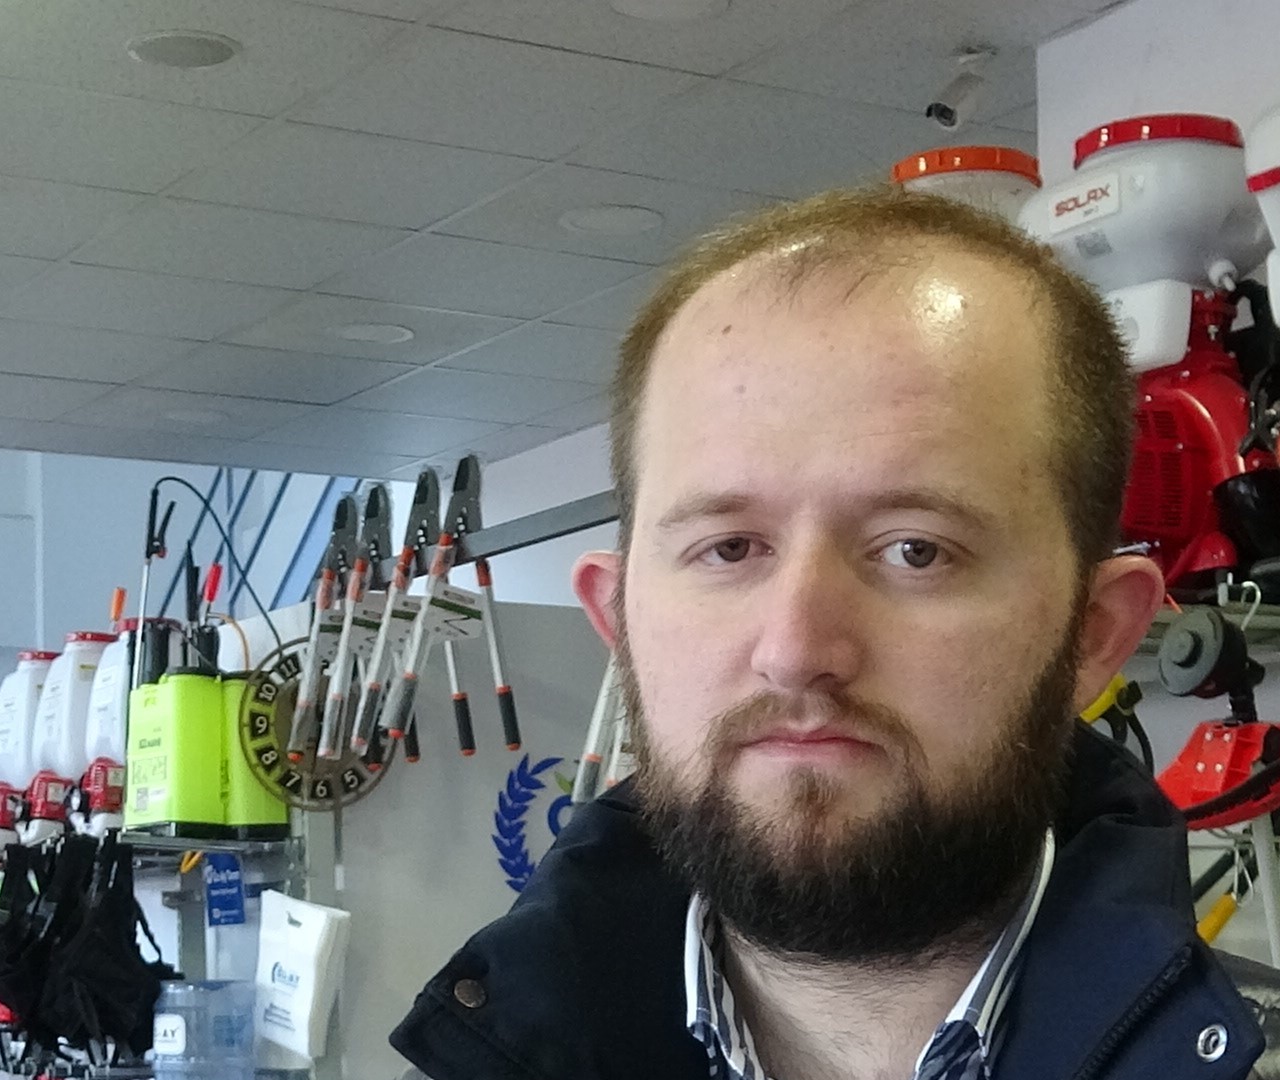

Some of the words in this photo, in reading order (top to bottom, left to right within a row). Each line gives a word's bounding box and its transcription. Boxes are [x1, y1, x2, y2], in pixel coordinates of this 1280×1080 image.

[1054, 183, 1111, 217] SOLAX
[279, 659, 295, 677] 11
[258, 683, 277, 702] 10
[255, 716, 268, 733] 9
[261, 750, 277, 765] 8
[285, 771, 301, 788] 7
[343, 769, 359, 788] 5
[315, 780, 328, 798] 6
